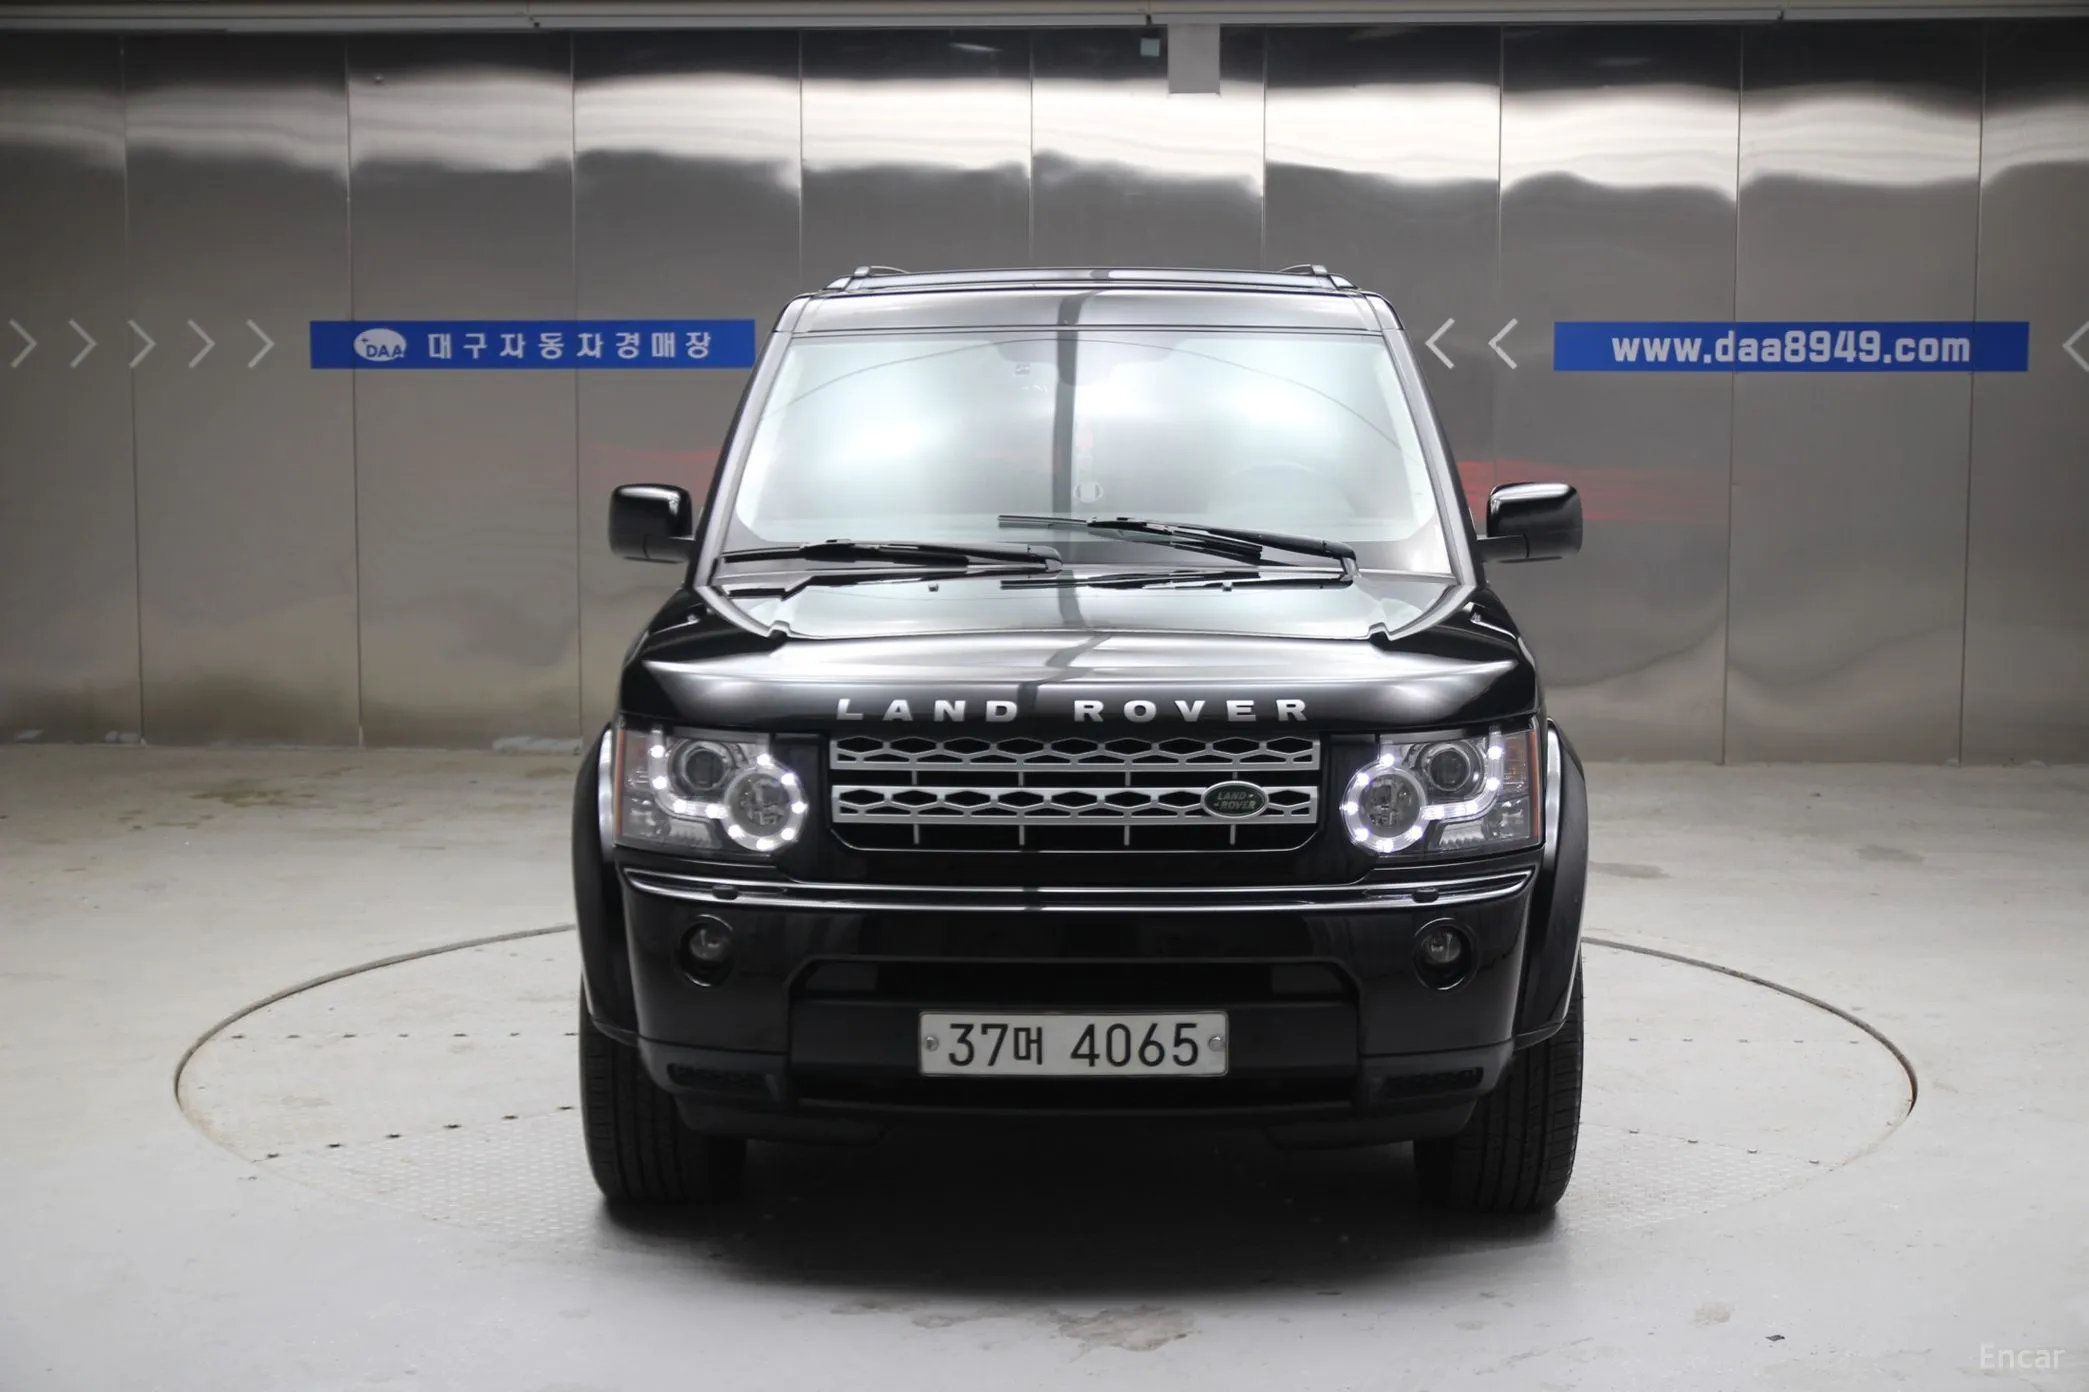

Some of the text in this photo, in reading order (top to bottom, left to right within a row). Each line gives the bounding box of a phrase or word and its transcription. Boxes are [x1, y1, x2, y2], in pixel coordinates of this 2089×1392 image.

[1611, 330, 1971, 364] www.daa8949.com
[836, 698, 1307, 722] LAND ROVER
[1216, 791, 1247, 801] LAND
[1220, 800, 1257, 810] ROVER
[948, 1022, 1199, 1067] 37머 4065
